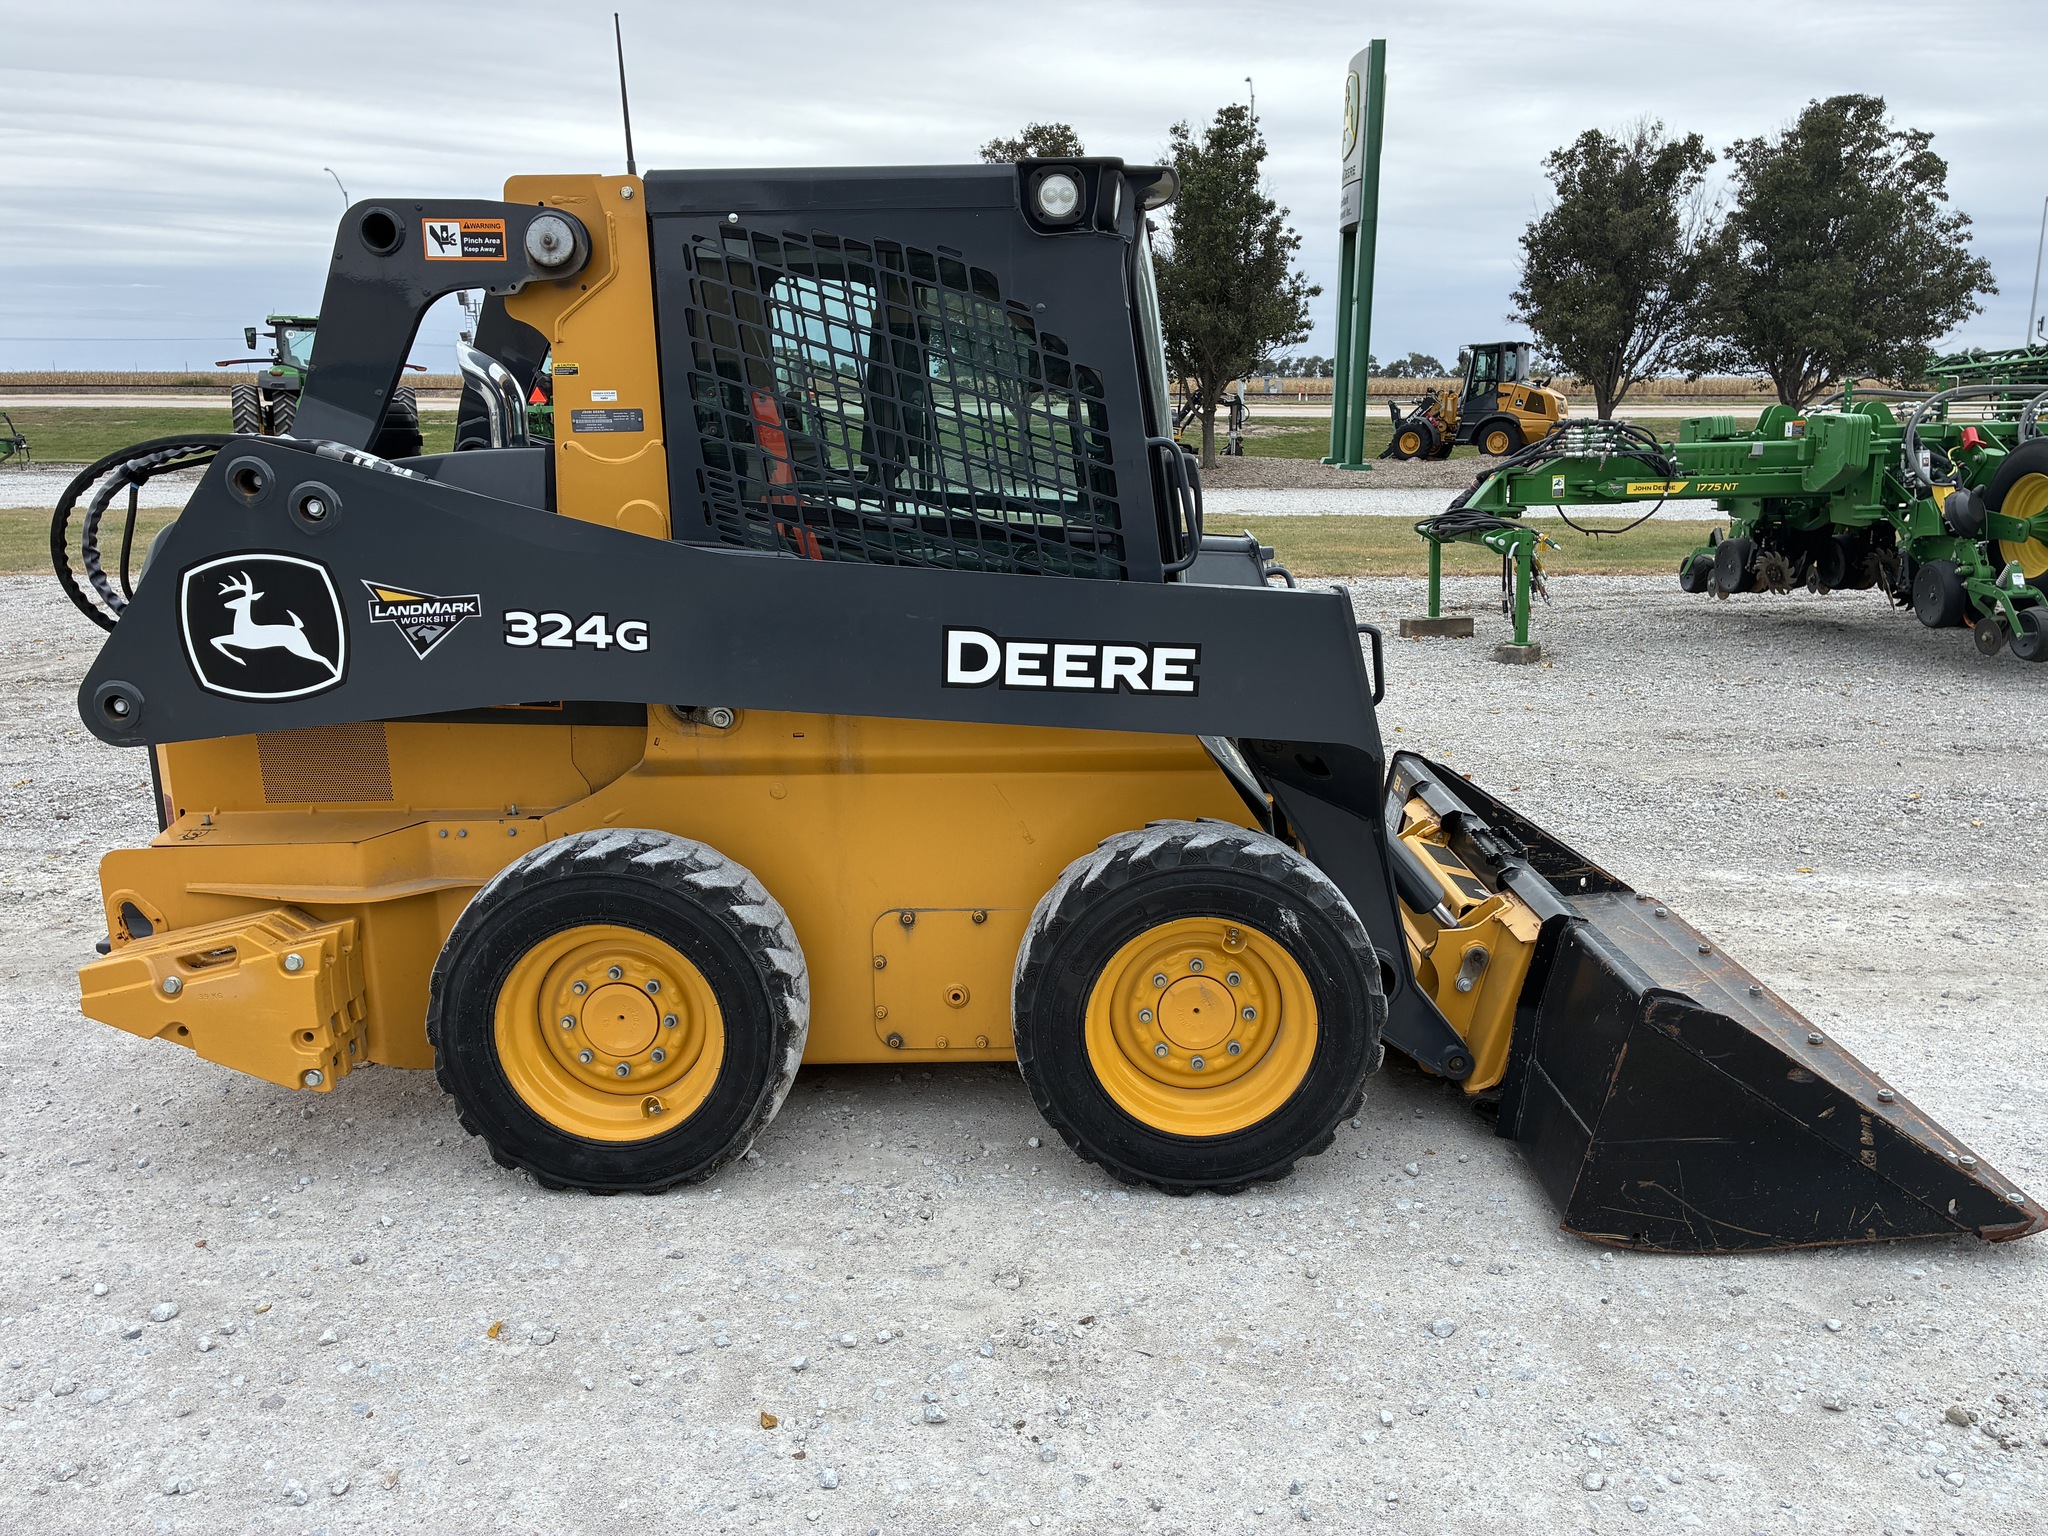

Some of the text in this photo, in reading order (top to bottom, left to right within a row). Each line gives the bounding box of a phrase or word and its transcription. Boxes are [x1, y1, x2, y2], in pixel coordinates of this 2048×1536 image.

[1405, 406, 1424, 424] DEERE
[1696, 482, 1739, 492] 1775 NT
[400, 614, 457, 625] WORKSITE
[505, 611, 648, 651] 324G
[947, 630, 1197, 692] DEERE
